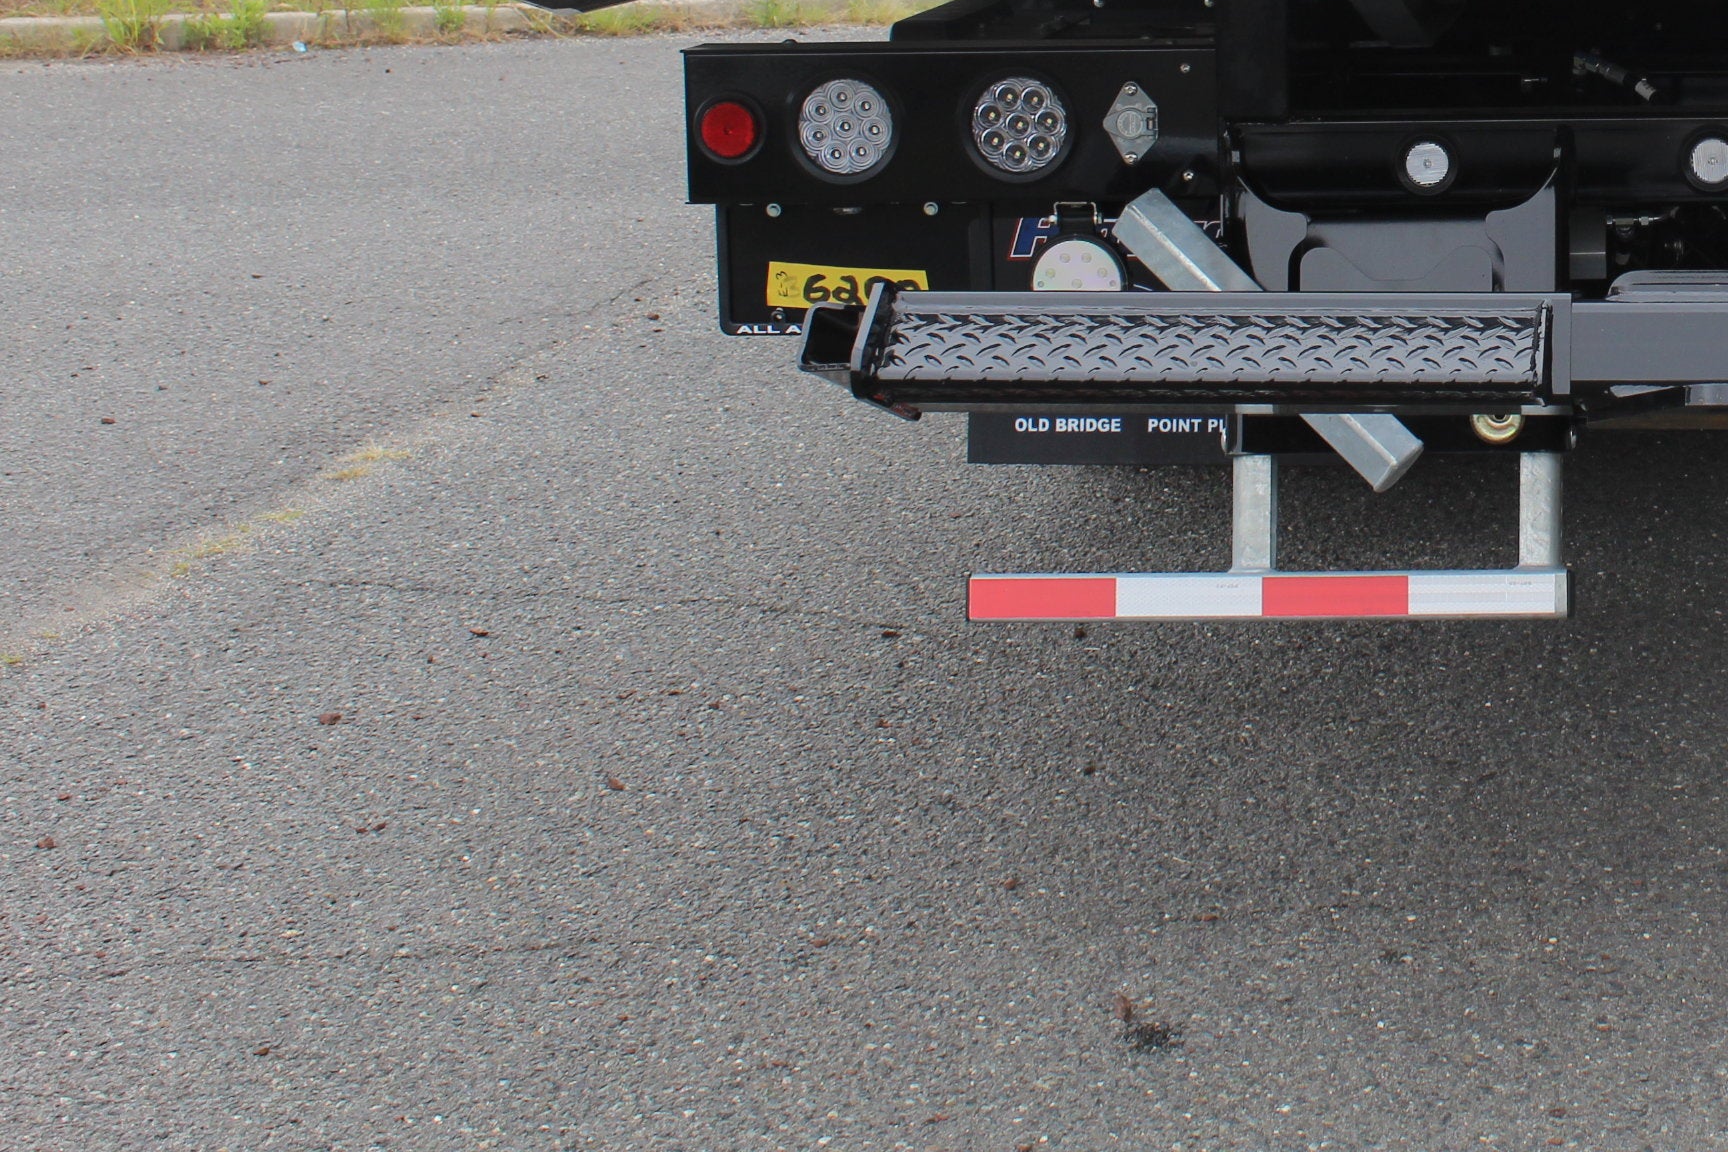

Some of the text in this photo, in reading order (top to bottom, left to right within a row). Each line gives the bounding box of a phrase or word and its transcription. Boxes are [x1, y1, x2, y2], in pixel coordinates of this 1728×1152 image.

[736, 325, 781, 334] ALL
[1014, 417, 1050, 432] OLD
[1055, 417, 1121, 432] BRIDGE
[1147, 418, 1202, 433] POINT
